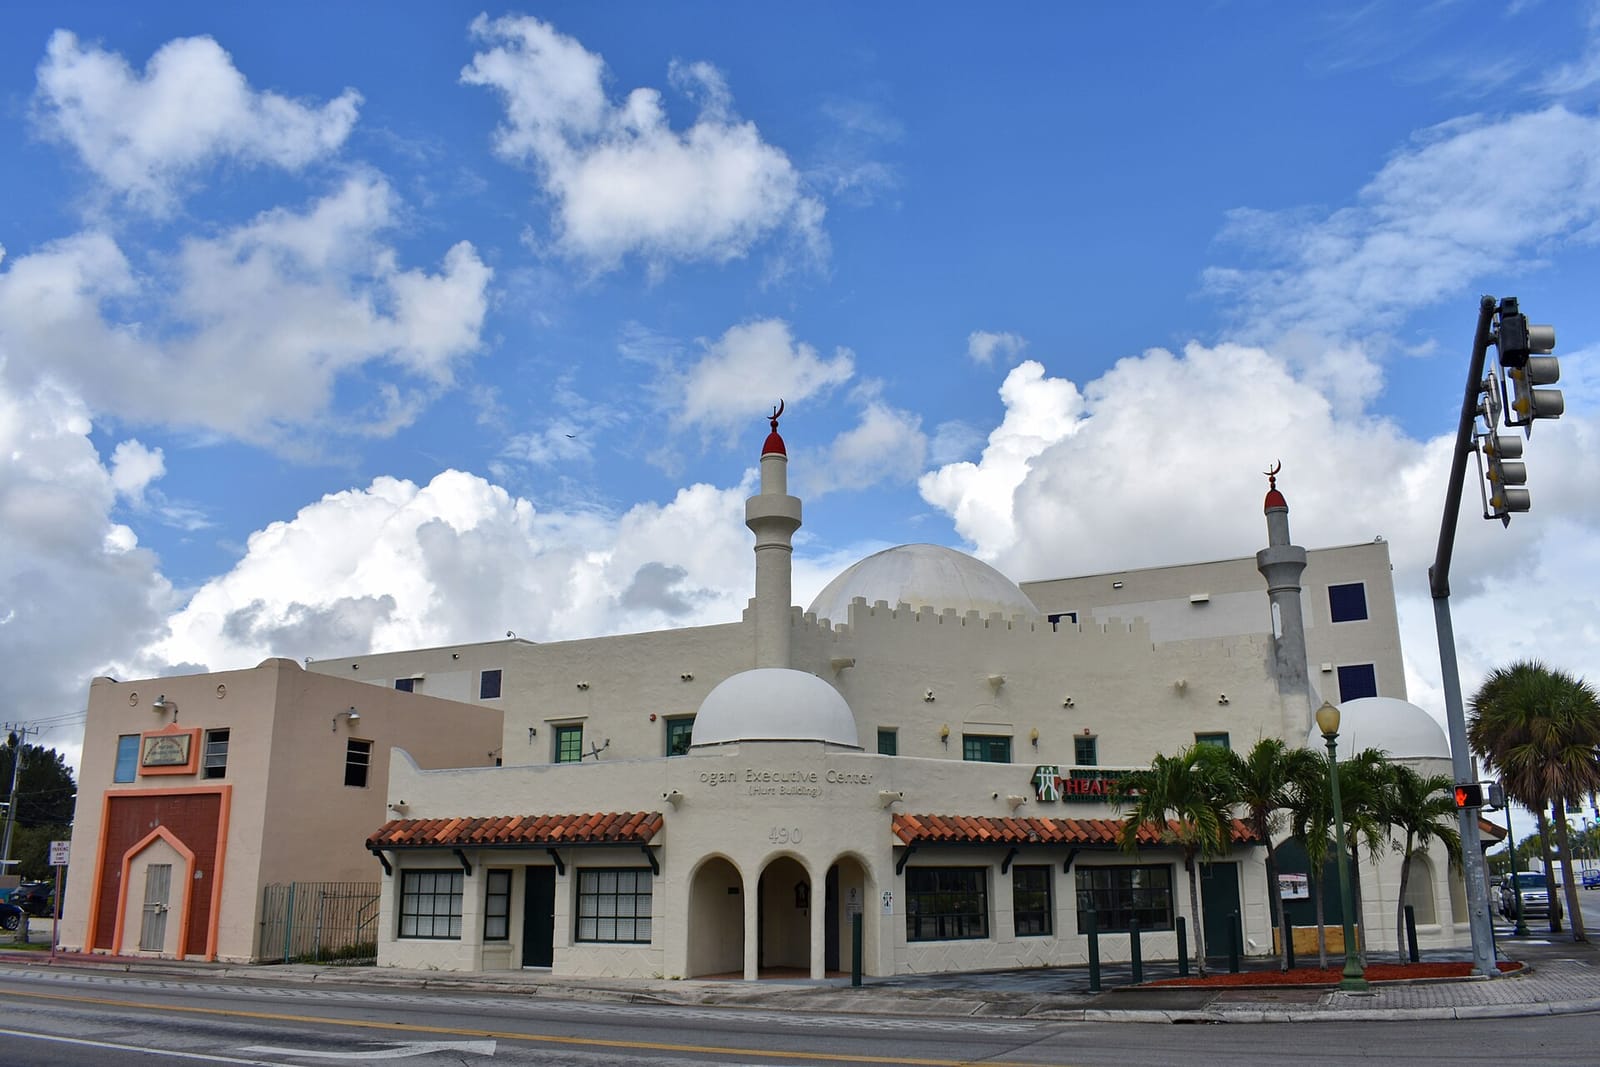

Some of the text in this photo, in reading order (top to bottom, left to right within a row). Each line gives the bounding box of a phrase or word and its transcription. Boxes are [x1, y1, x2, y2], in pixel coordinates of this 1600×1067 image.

[744, 767, 818, 783] Executive
[825, 769, 873, 785] Center
[767, 826, 803, 845] 490
